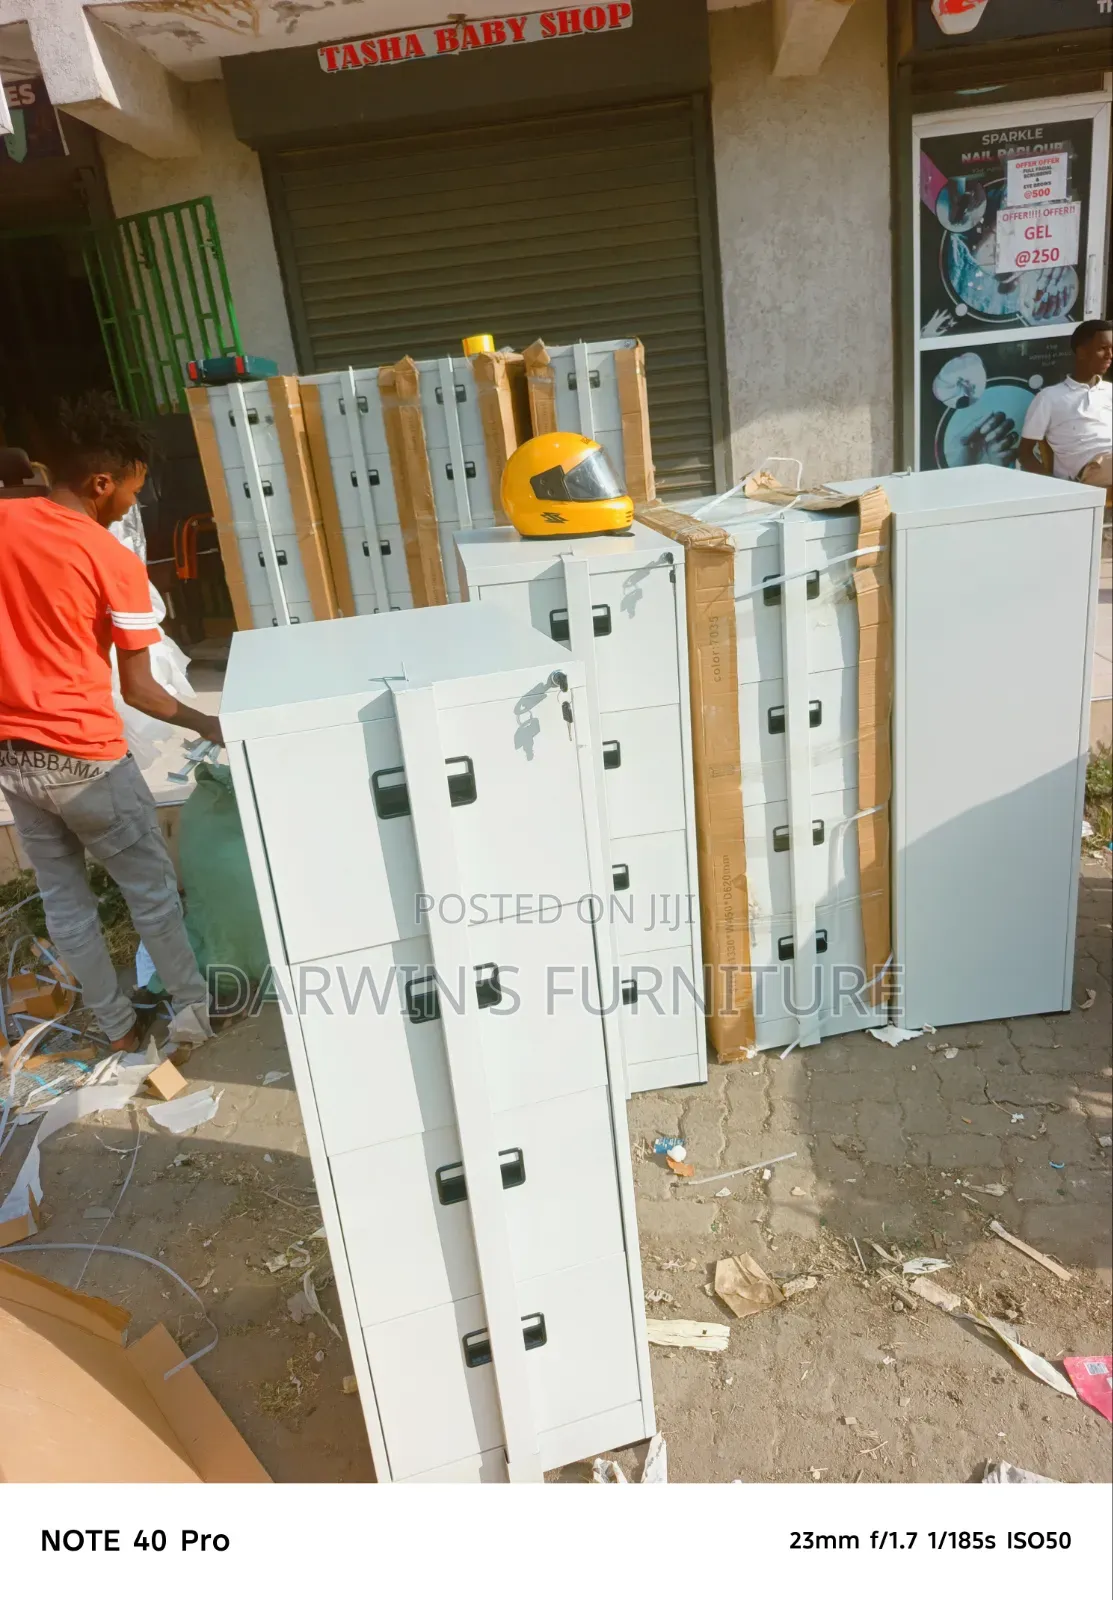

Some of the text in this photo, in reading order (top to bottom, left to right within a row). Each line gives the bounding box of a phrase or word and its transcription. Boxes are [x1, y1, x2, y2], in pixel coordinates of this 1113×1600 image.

[320, 2, 632, 72] TASHA BABY SHOP
[982, 128, 1043, 145] SPARKLE
[961, 151, 993, 162] NAIL
[1015, 158, 1060, 169] OFFER OFFER
[1024, 187, 1051, 200] @500
[1024, 224, 1053, 241] GEL
[1015, 247, 1060, 269] @250
